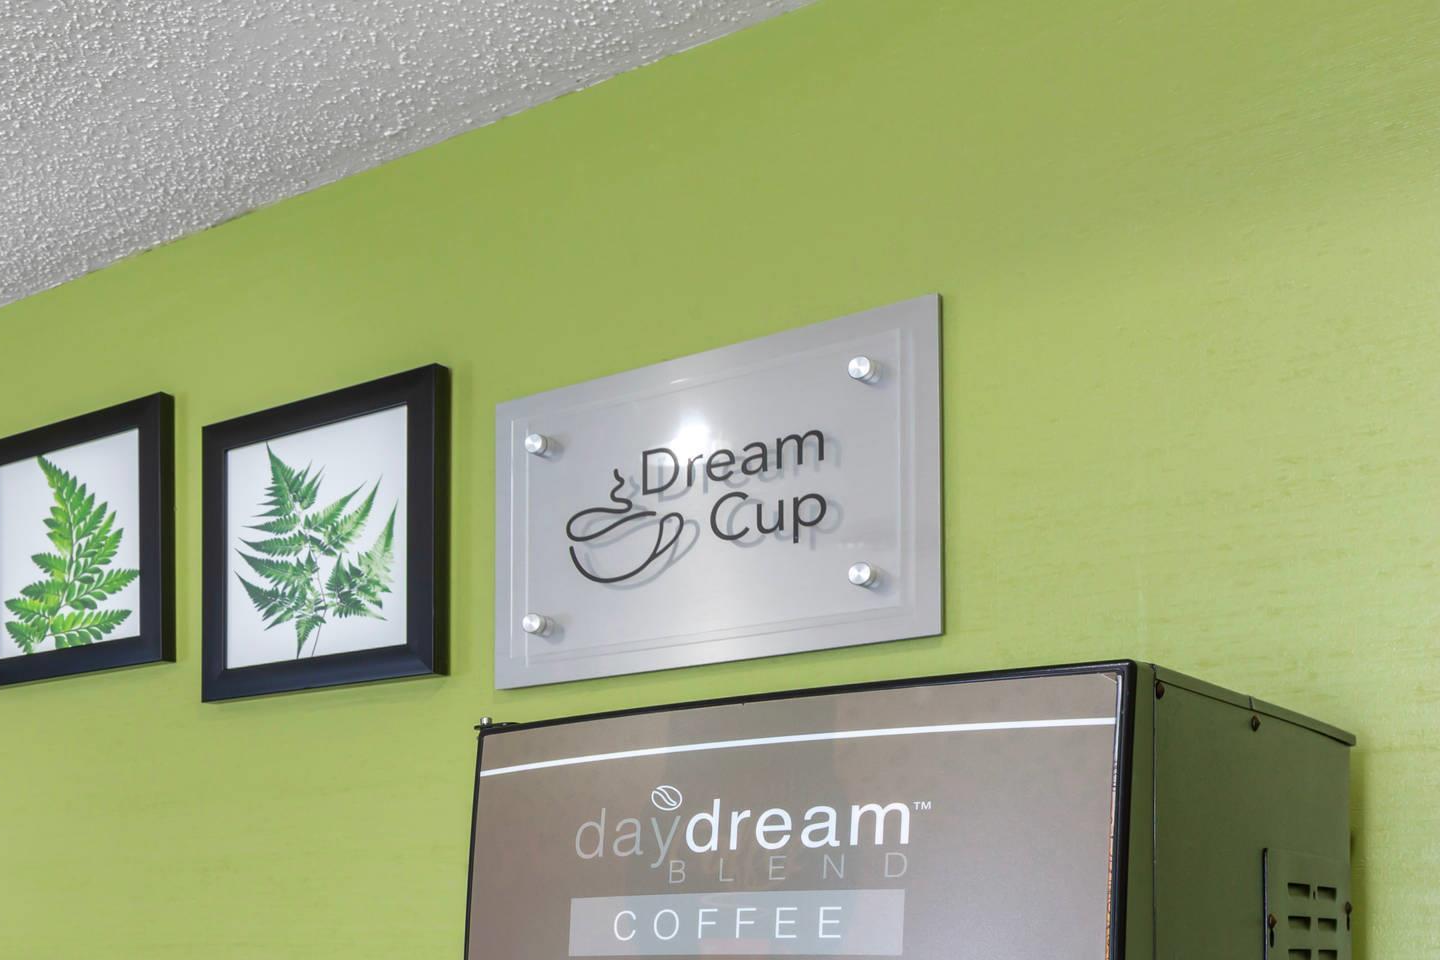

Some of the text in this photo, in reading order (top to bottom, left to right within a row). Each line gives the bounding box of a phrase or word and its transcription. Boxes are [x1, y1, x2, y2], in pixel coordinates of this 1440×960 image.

[642, 429, 825, 495] Dream
[710, 491, 828, 544] Cup
[574, 798, 911, 869] daydream
[668, 852, 908, 884] BLEND
[613, 906, 843, 941] COFFEE
